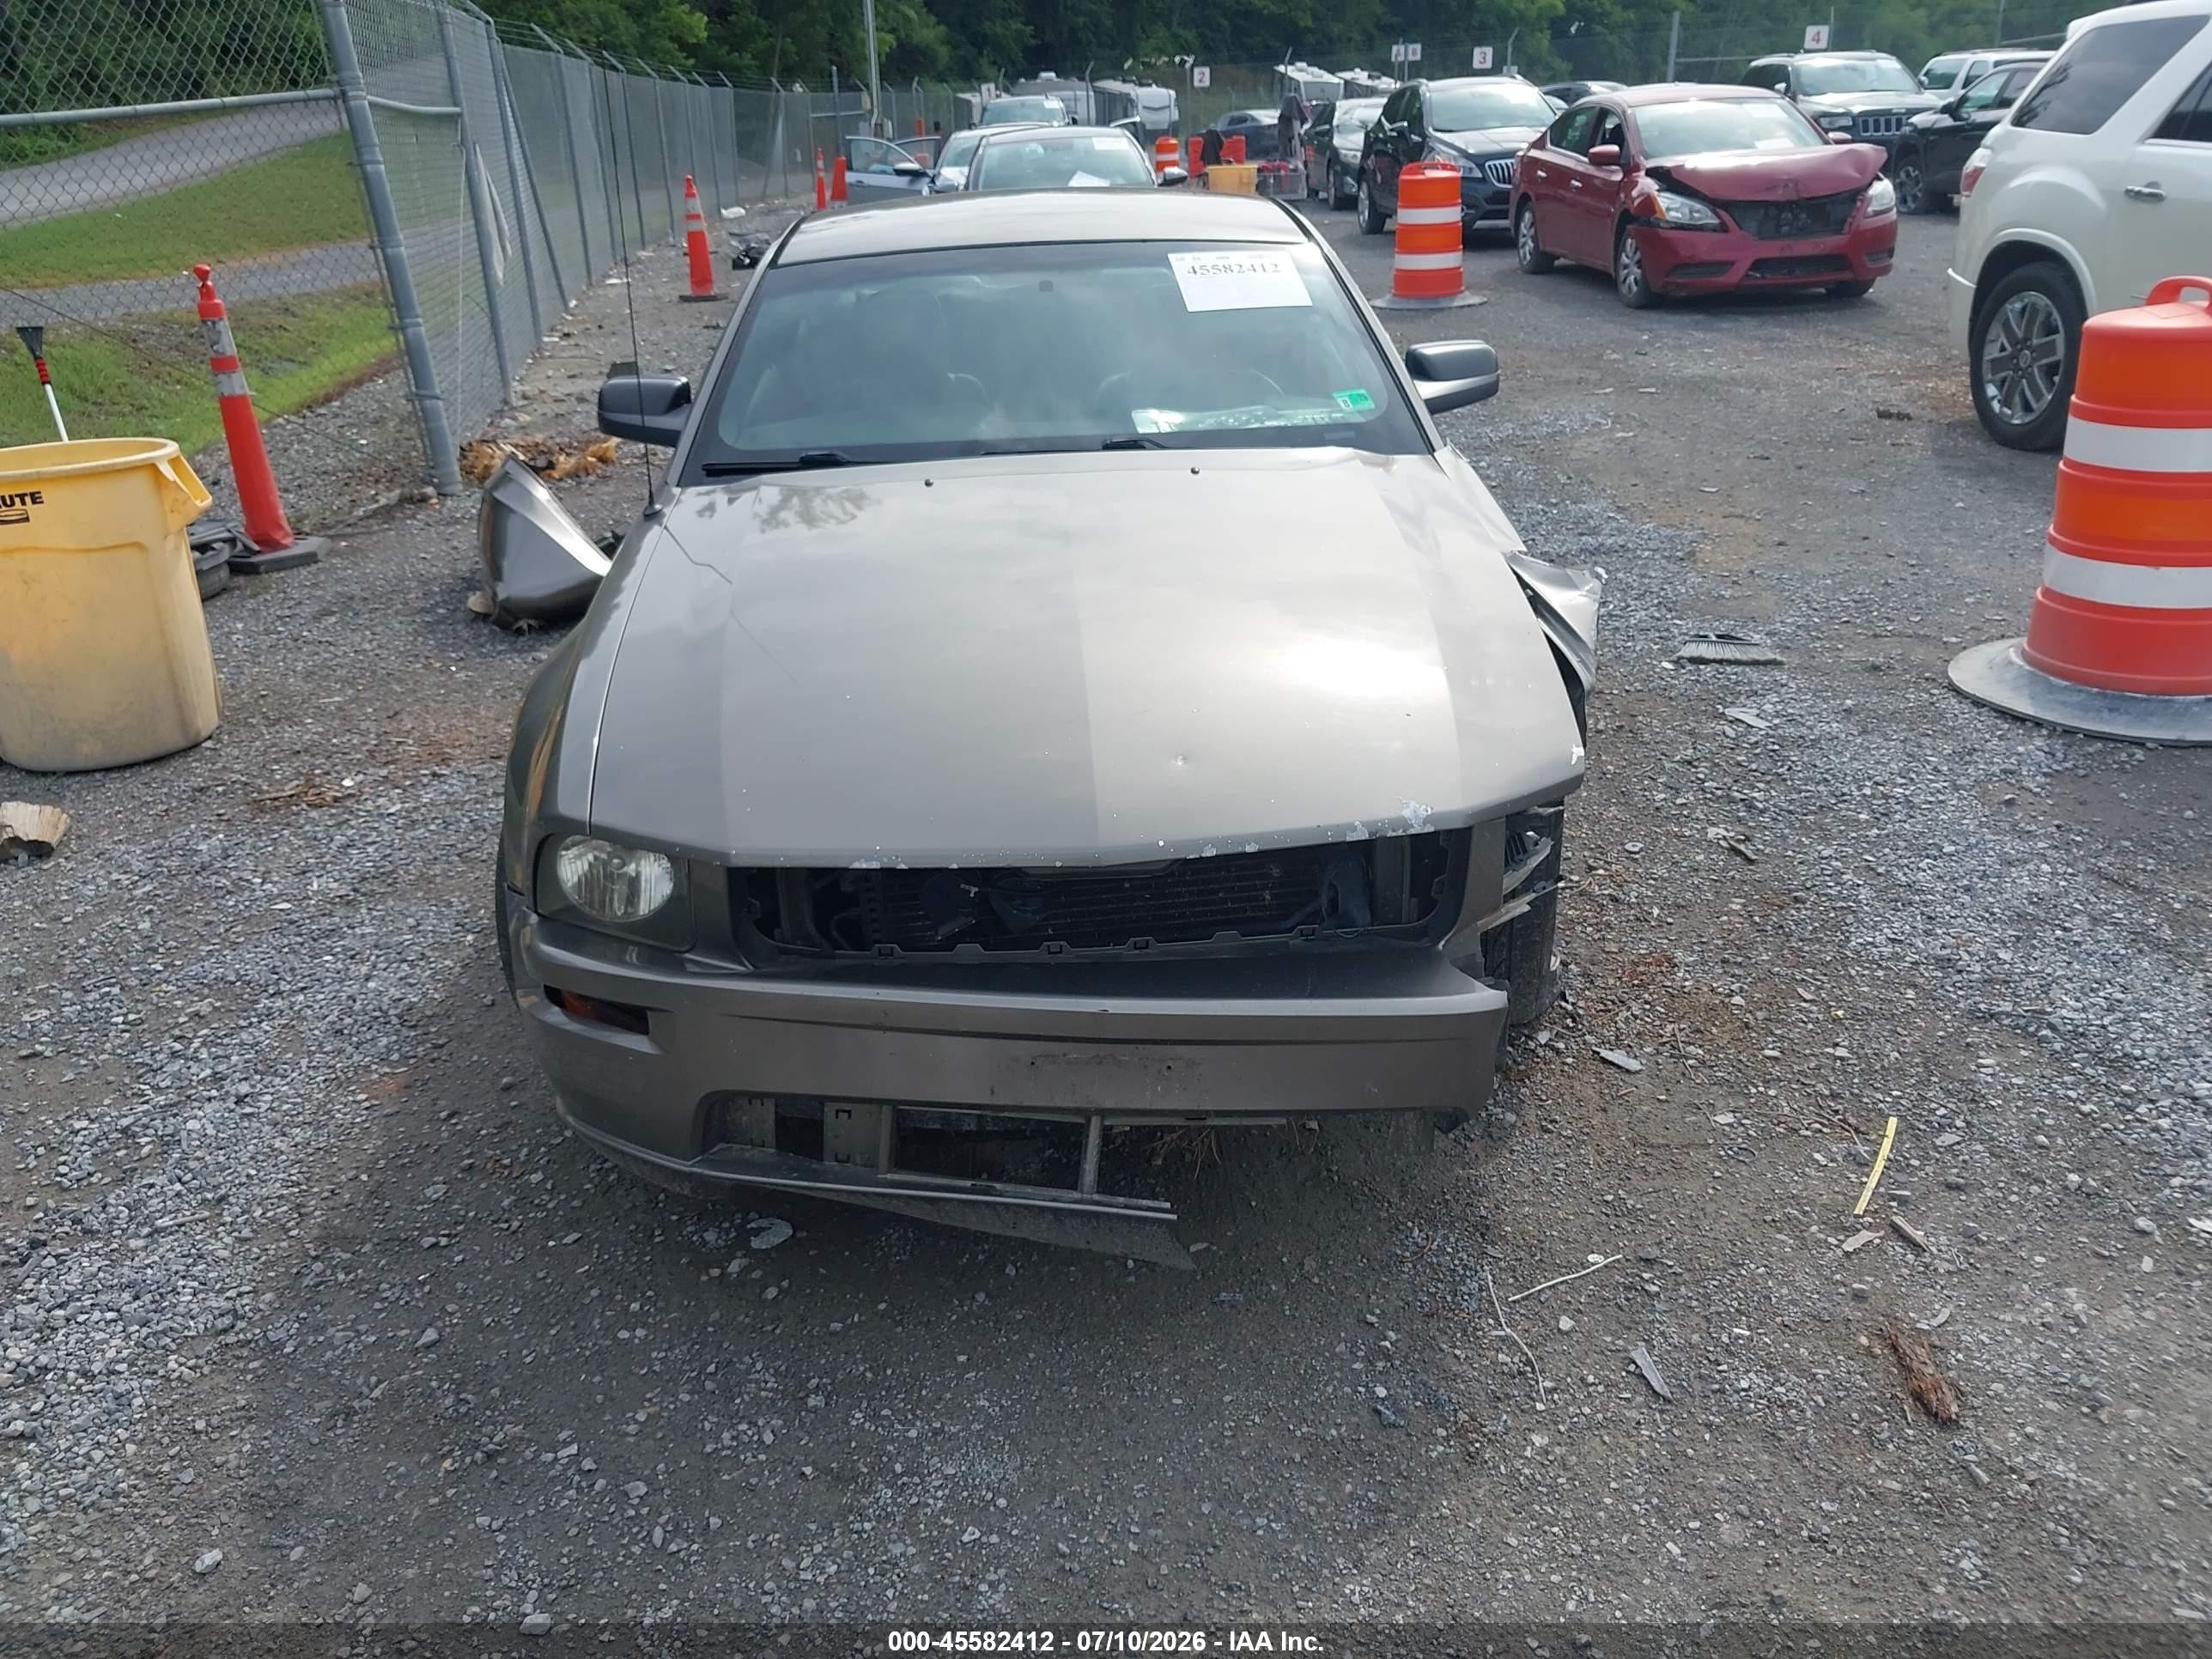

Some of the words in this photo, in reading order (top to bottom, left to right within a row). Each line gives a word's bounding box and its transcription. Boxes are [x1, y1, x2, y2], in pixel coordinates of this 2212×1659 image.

[1811, 30, 1821, 45] 4
[1479, 51, 1487, 64] 3
[1198, 71, 1206, 83] 2
[1187, 262, 1281, 276] 45582412
[0, 490, 45, 509] UTE
